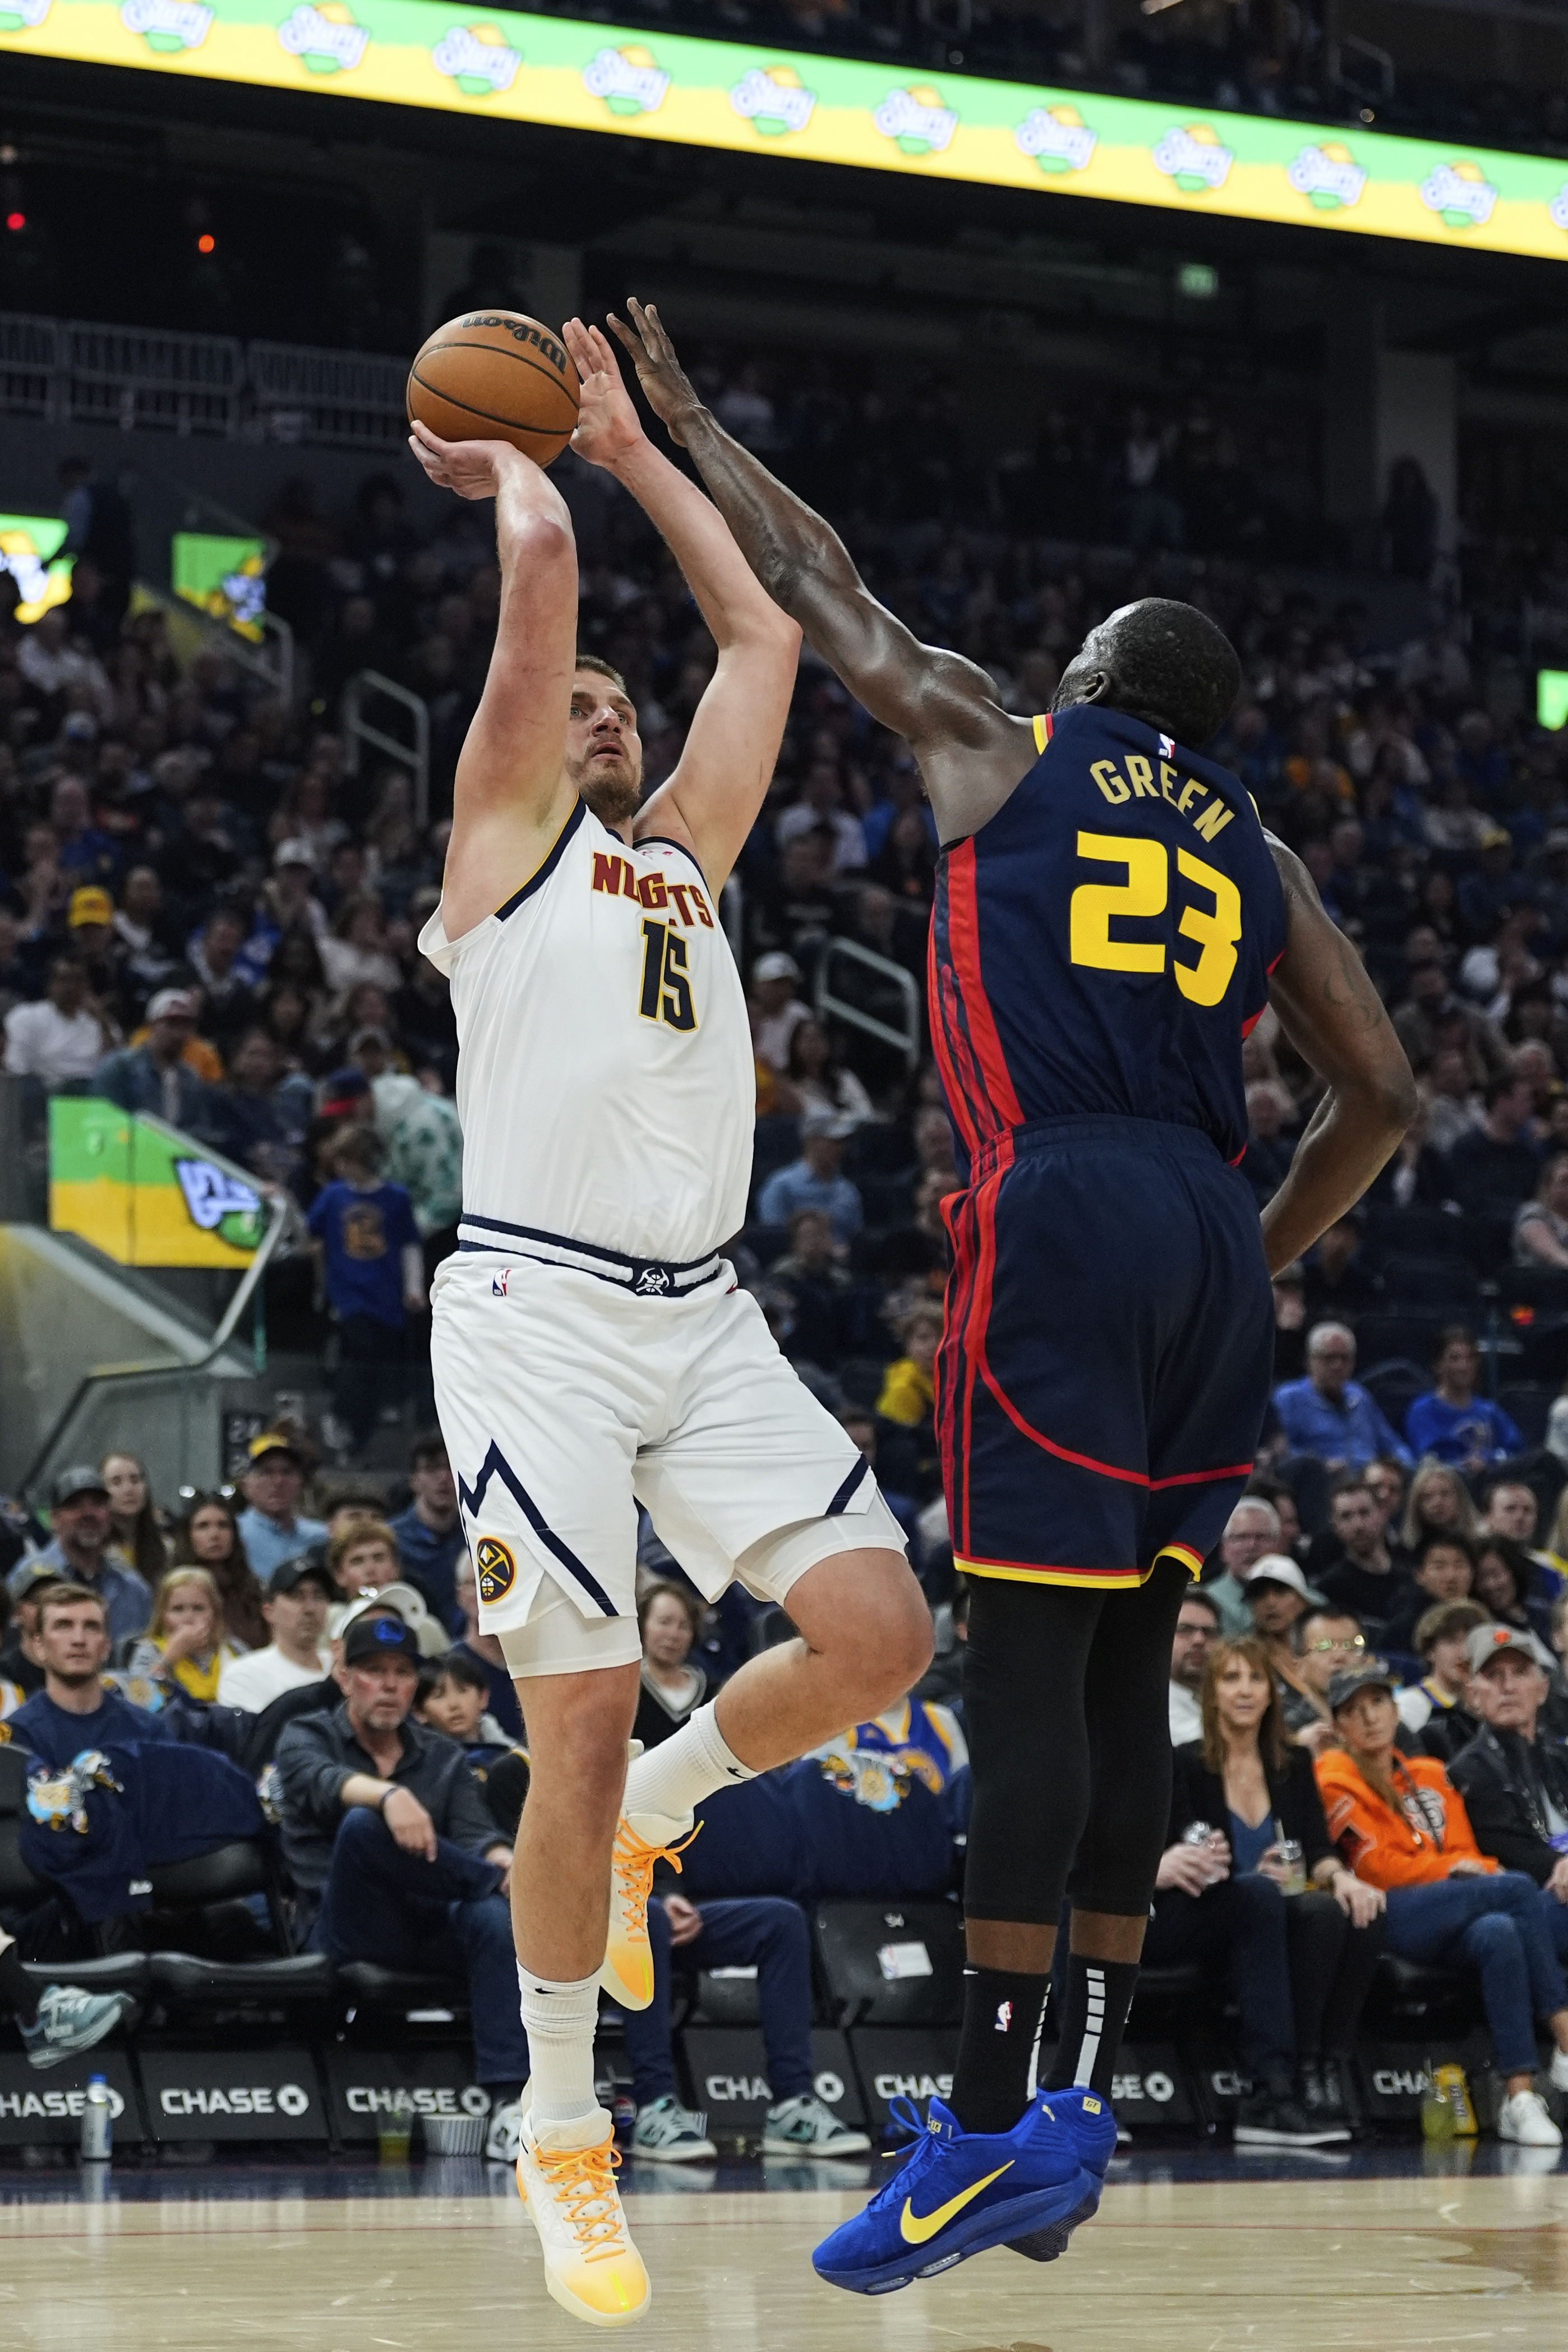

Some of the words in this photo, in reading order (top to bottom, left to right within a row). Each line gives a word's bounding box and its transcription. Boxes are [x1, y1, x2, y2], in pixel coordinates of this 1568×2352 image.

[1090, 755, 1235, 842] GREEN
[1070, 830, 1243, 1007] 23
[638, 916, 699, 1034] 15
[706, 2074, 774, 2101] CHA
[873, 2074, 954, 2100] CHAS
[1373, 2069, 1431, 2095] CHA
[0, 2089, 87, 2118] HASE
[160, 2087, 276, 2114] CHASE
[346, 2086, 458, 2113] CHASE
